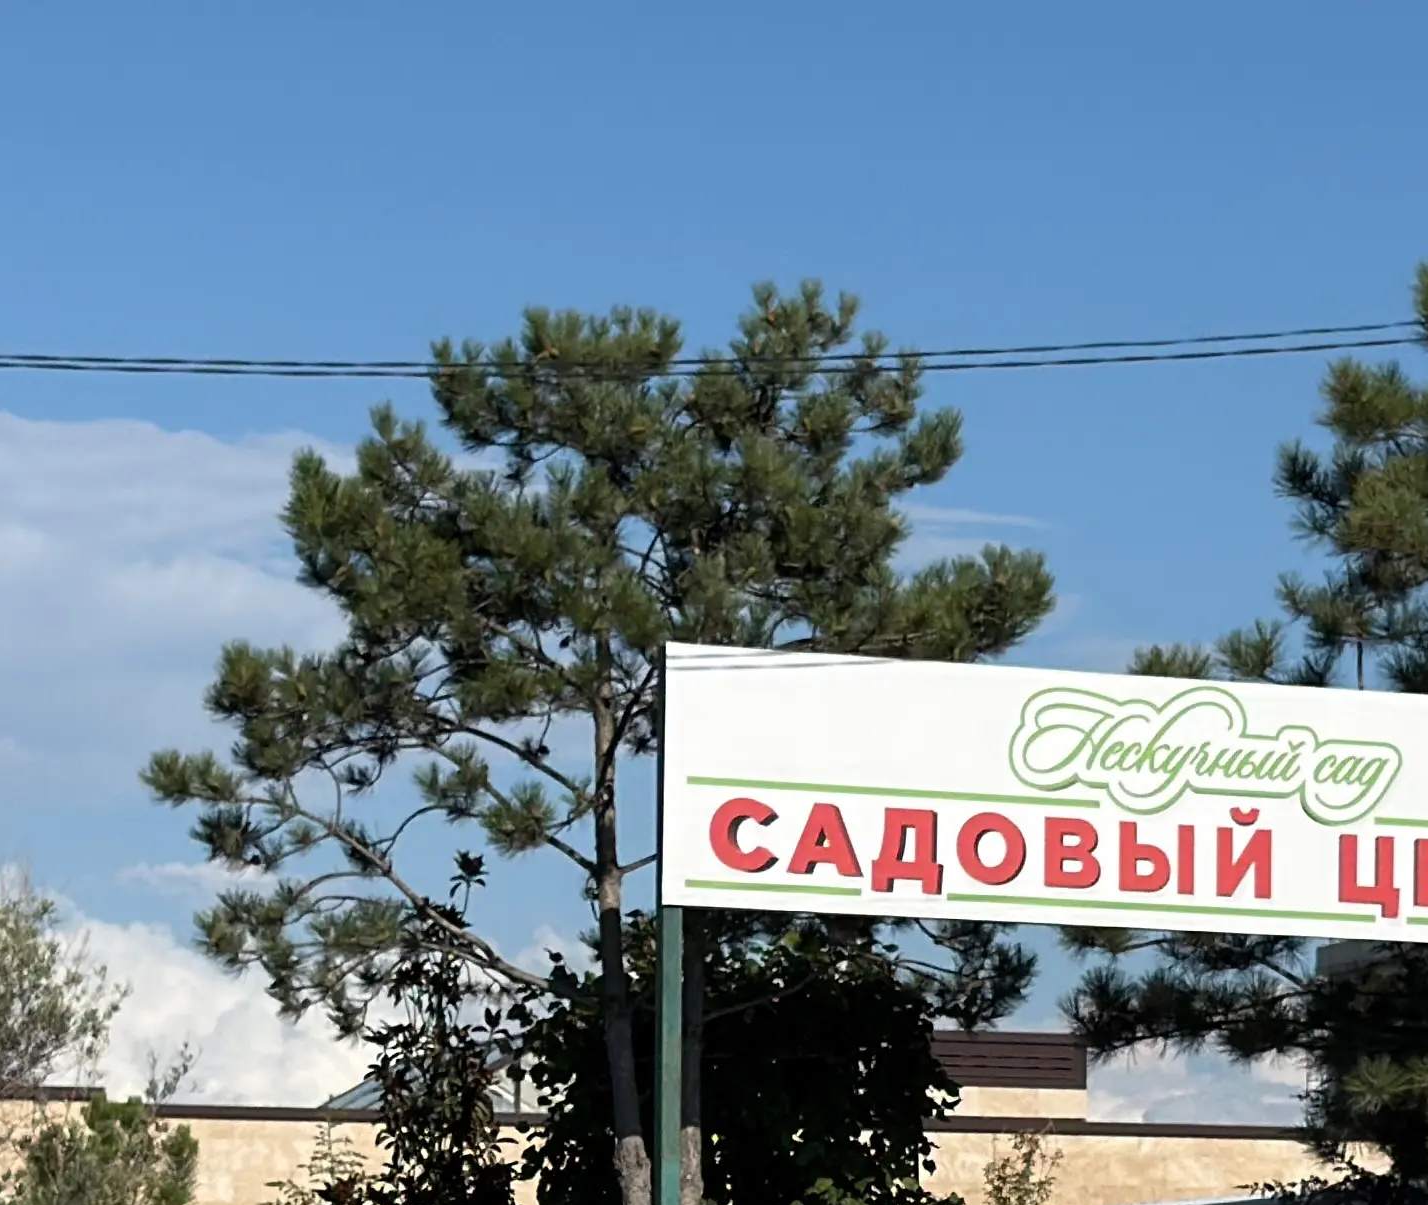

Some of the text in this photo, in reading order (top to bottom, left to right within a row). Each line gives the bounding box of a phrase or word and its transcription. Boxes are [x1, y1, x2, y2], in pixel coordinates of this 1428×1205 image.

[1022, 701, 1391, 810] Нескучный сад
[708, 797, 1274, 900] САДОВЫЙ
